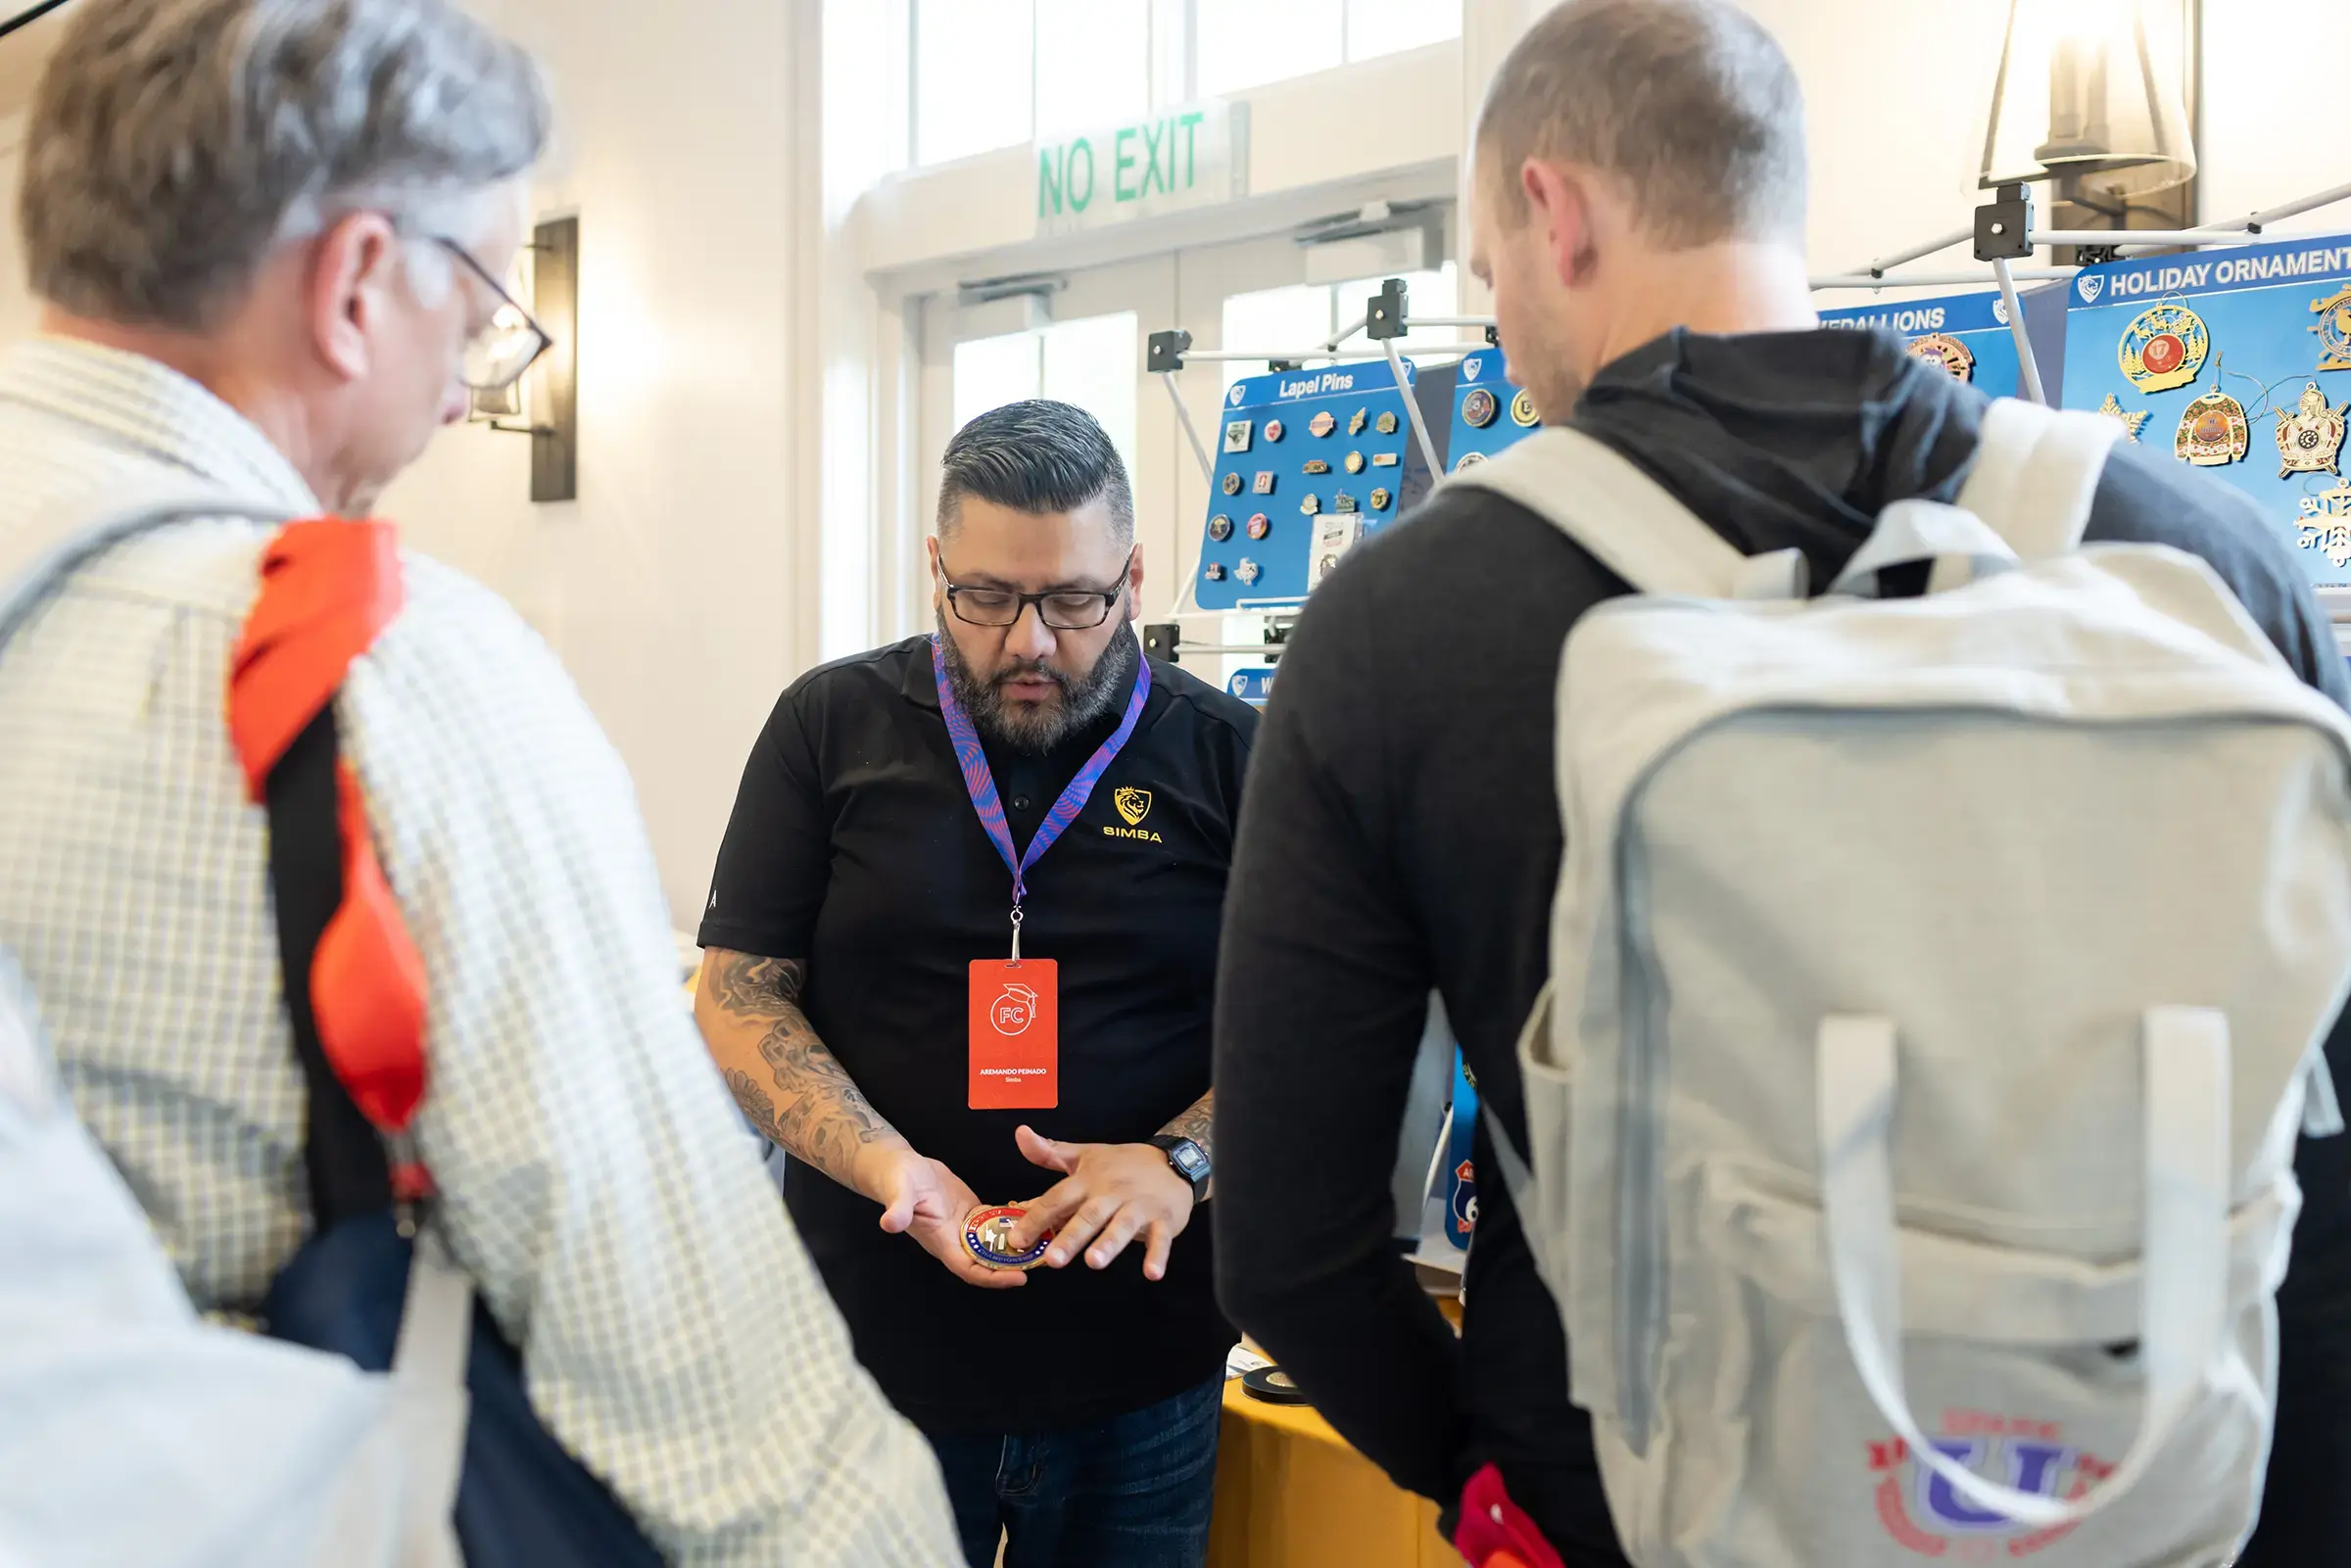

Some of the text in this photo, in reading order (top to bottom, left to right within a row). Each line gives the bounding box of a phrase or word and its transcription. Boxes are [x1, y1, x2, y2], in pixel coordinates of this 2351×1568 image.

[1038, 112, 1204, 218] NO EXIT
[2110, 261, 2214, 296] HOLIDAY
[1279, 373, 1354, 399] Lapel Pins
[1103, 826, 1163, 843] SIMBA
[999, 1007, 1025, 1023] FC
